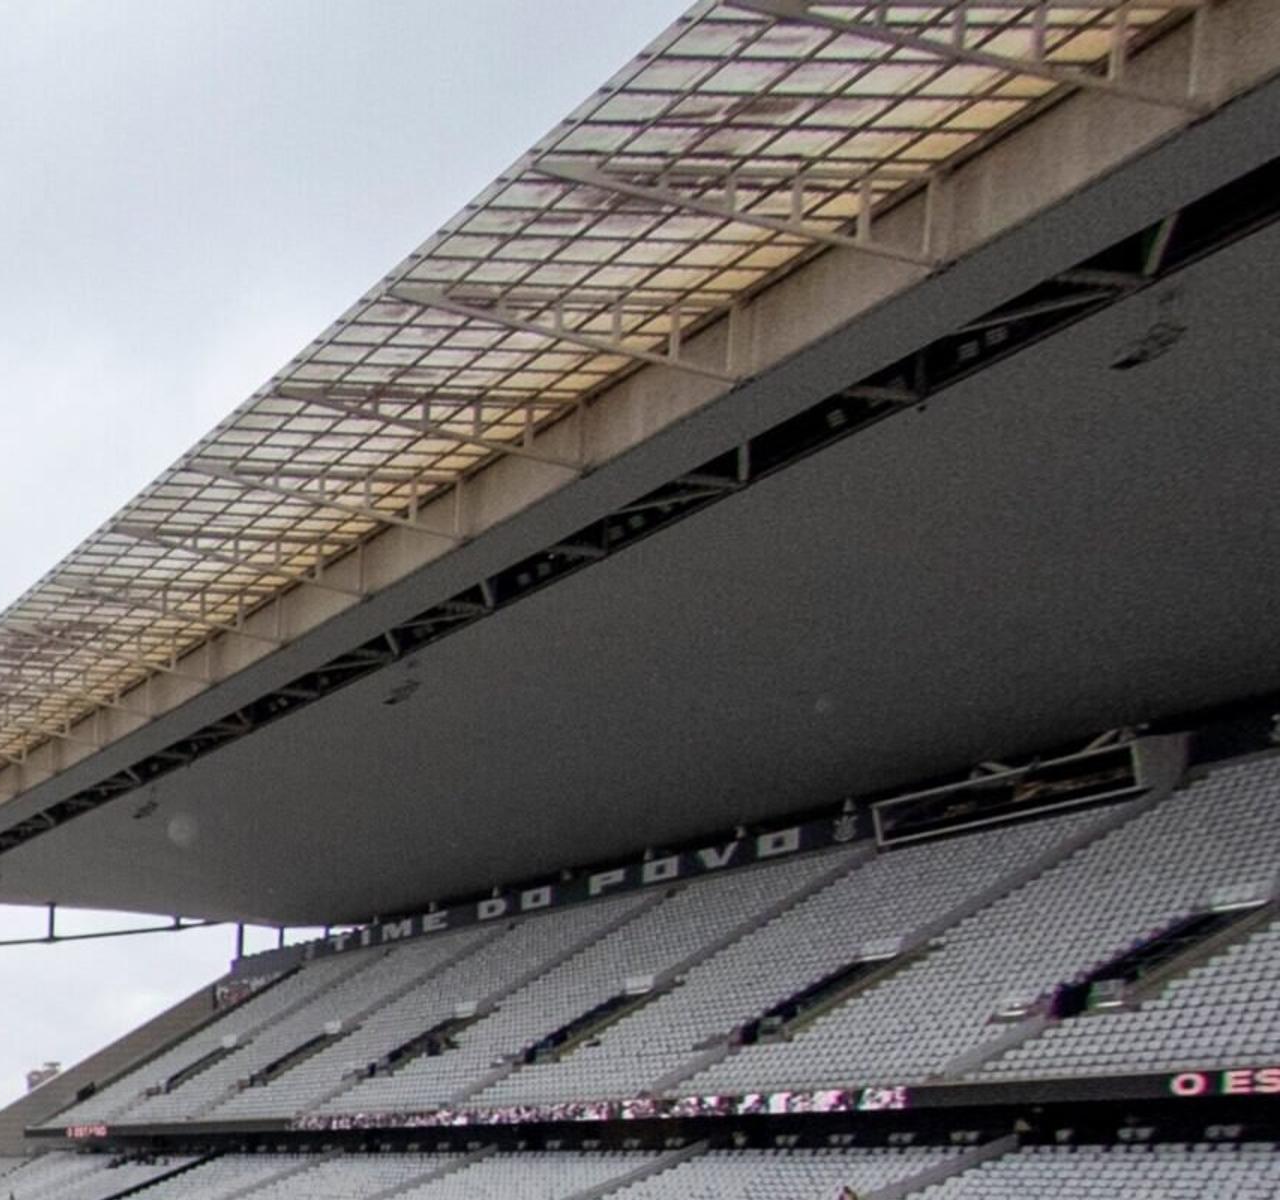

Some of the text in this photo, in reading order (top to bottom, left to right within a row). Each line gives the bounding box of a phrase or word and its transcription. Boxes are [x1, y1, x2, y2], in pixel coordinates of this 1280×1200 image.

[329, 827, 801, 951] TIME DO POVO
[1170, 1072, 1206, 1096] O
